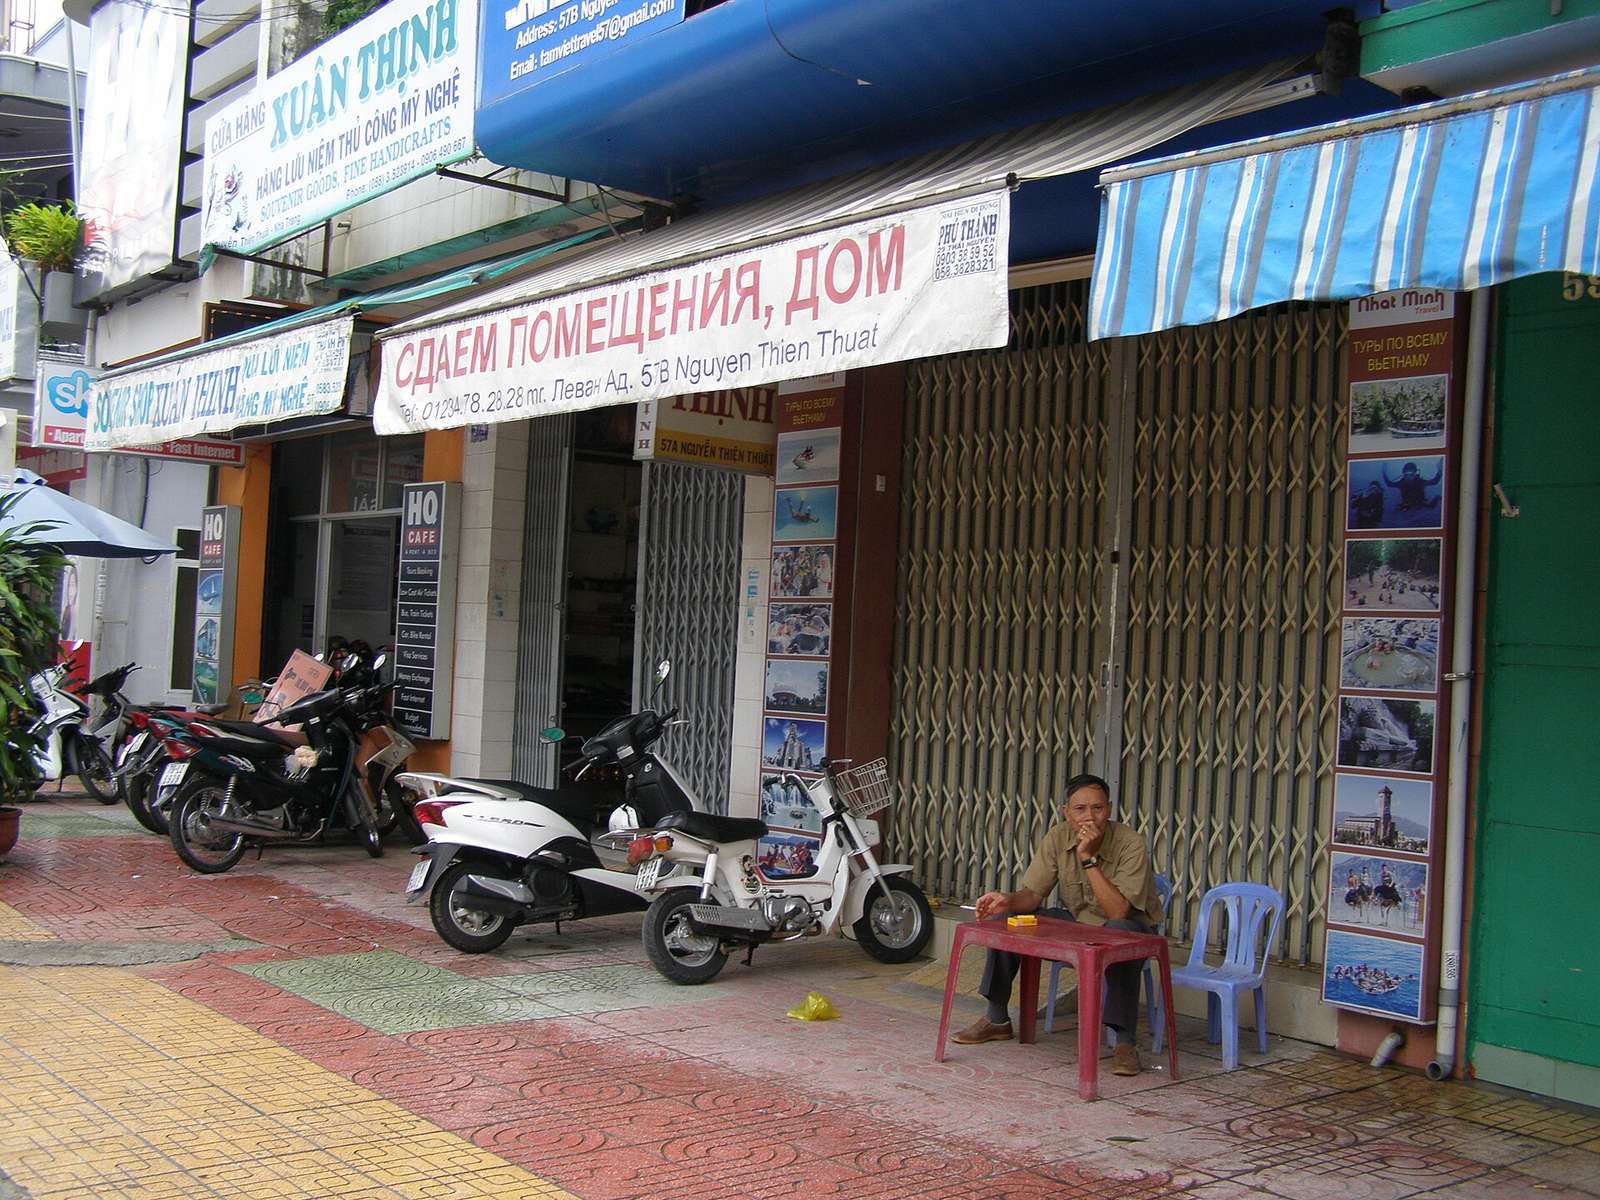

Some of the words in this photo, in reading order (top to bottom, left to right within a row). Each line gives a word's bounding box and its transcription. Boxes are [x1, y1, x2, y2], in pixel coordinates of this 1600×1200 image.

[516, 18, 558, 50] Address:
[559, 4, 579, 31] 57B
[270, 56, 350, 148] XUÂN
[357, 0, 458, 98] THỊNH
[510, 54, 538, 80] Email:
[211, 115, 232, 153] CỬA
[235, 101, 266, 140] HÀNG
[256, 168, 282, 201] HÀNG
[307, 138, 335, 177] NIỆM
[364, 109, 397, 146] CÔNG
[425, 67, 460, 117] NGHỆ
[260, 190, 304, 222] SOUVENIR
[306, 171, 340, 200] GOODS,
[343, 156, 367, 184] FINE
[369, 115, 451, 171] HANDICRAFTS
[938, 217, 960, 246] PHÚ
[395, 323, 497, 396] СДАЕМ
[506, 259, 774, 369] ПОМЕЩЕНИЯ,
[785, 223, 906, 327] ДОМ
[1402, 288, 1445, 312] Minh
[1386, 335, 1405, 350] ПО
[1407, 331, 1449, 349] ВСЕМУ
[551, 378, 602, 402] Леван
[605, 368, 634, 394] Ад.
[675, 348, 752, 386] Nguyen
[757, 338, 810, 369] Thien
[817, 322, 879, 358] Thuat
[1367, 353, 1430, 373] ВЬЕТНАМУ
[169, 441, 193, 456] Fast
[195, 443, 236, 460] Internet
[660, 438, 678, 453] 57A
[681, 439, 716, 458] NGUYỄN
[718, 445, 745, 461] THIỆN
[746, 447, 775, 466] THUẬT
[406, 490, 439, 525] HQ
[204, 513, 223, 541] HQ
[407, 530, 436, 544] CAFE
[204, 544, 221, 555] CAFE
